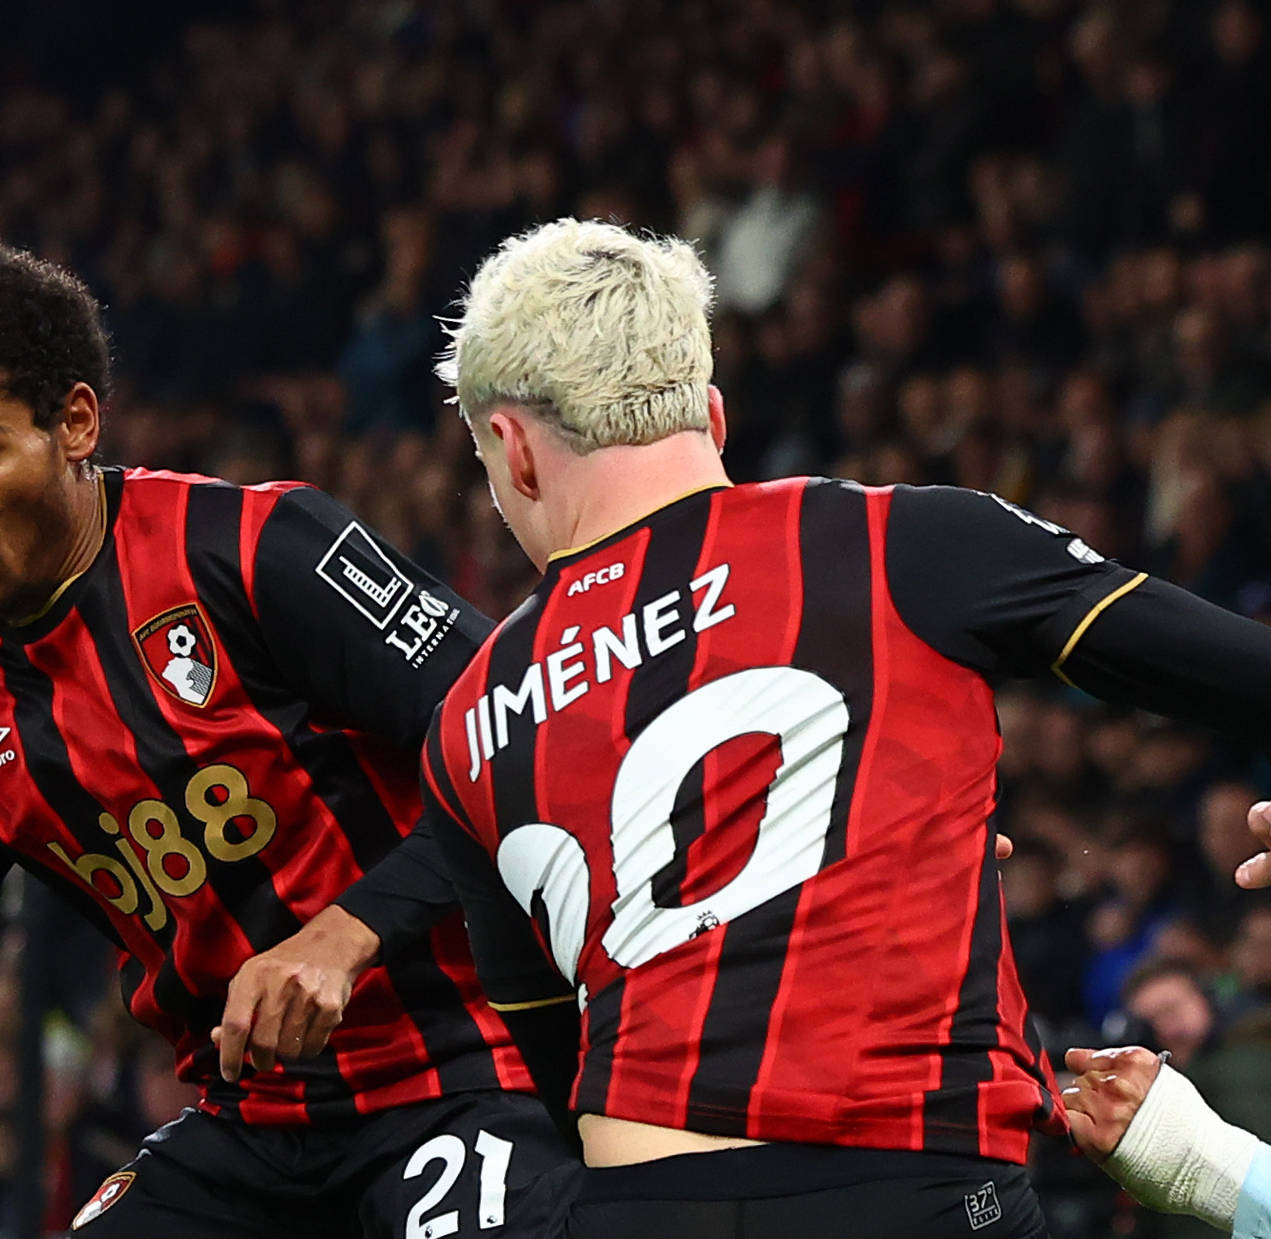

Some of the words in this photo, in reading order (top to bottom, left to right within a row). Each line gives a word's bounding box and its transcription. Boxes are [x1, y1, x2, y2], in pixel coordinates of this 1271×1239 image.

[567, 562, 625, 597] AFCB
[465, 563, 736, 782] JIMÉNEZ
[46, 764, 277, 932] bj88
